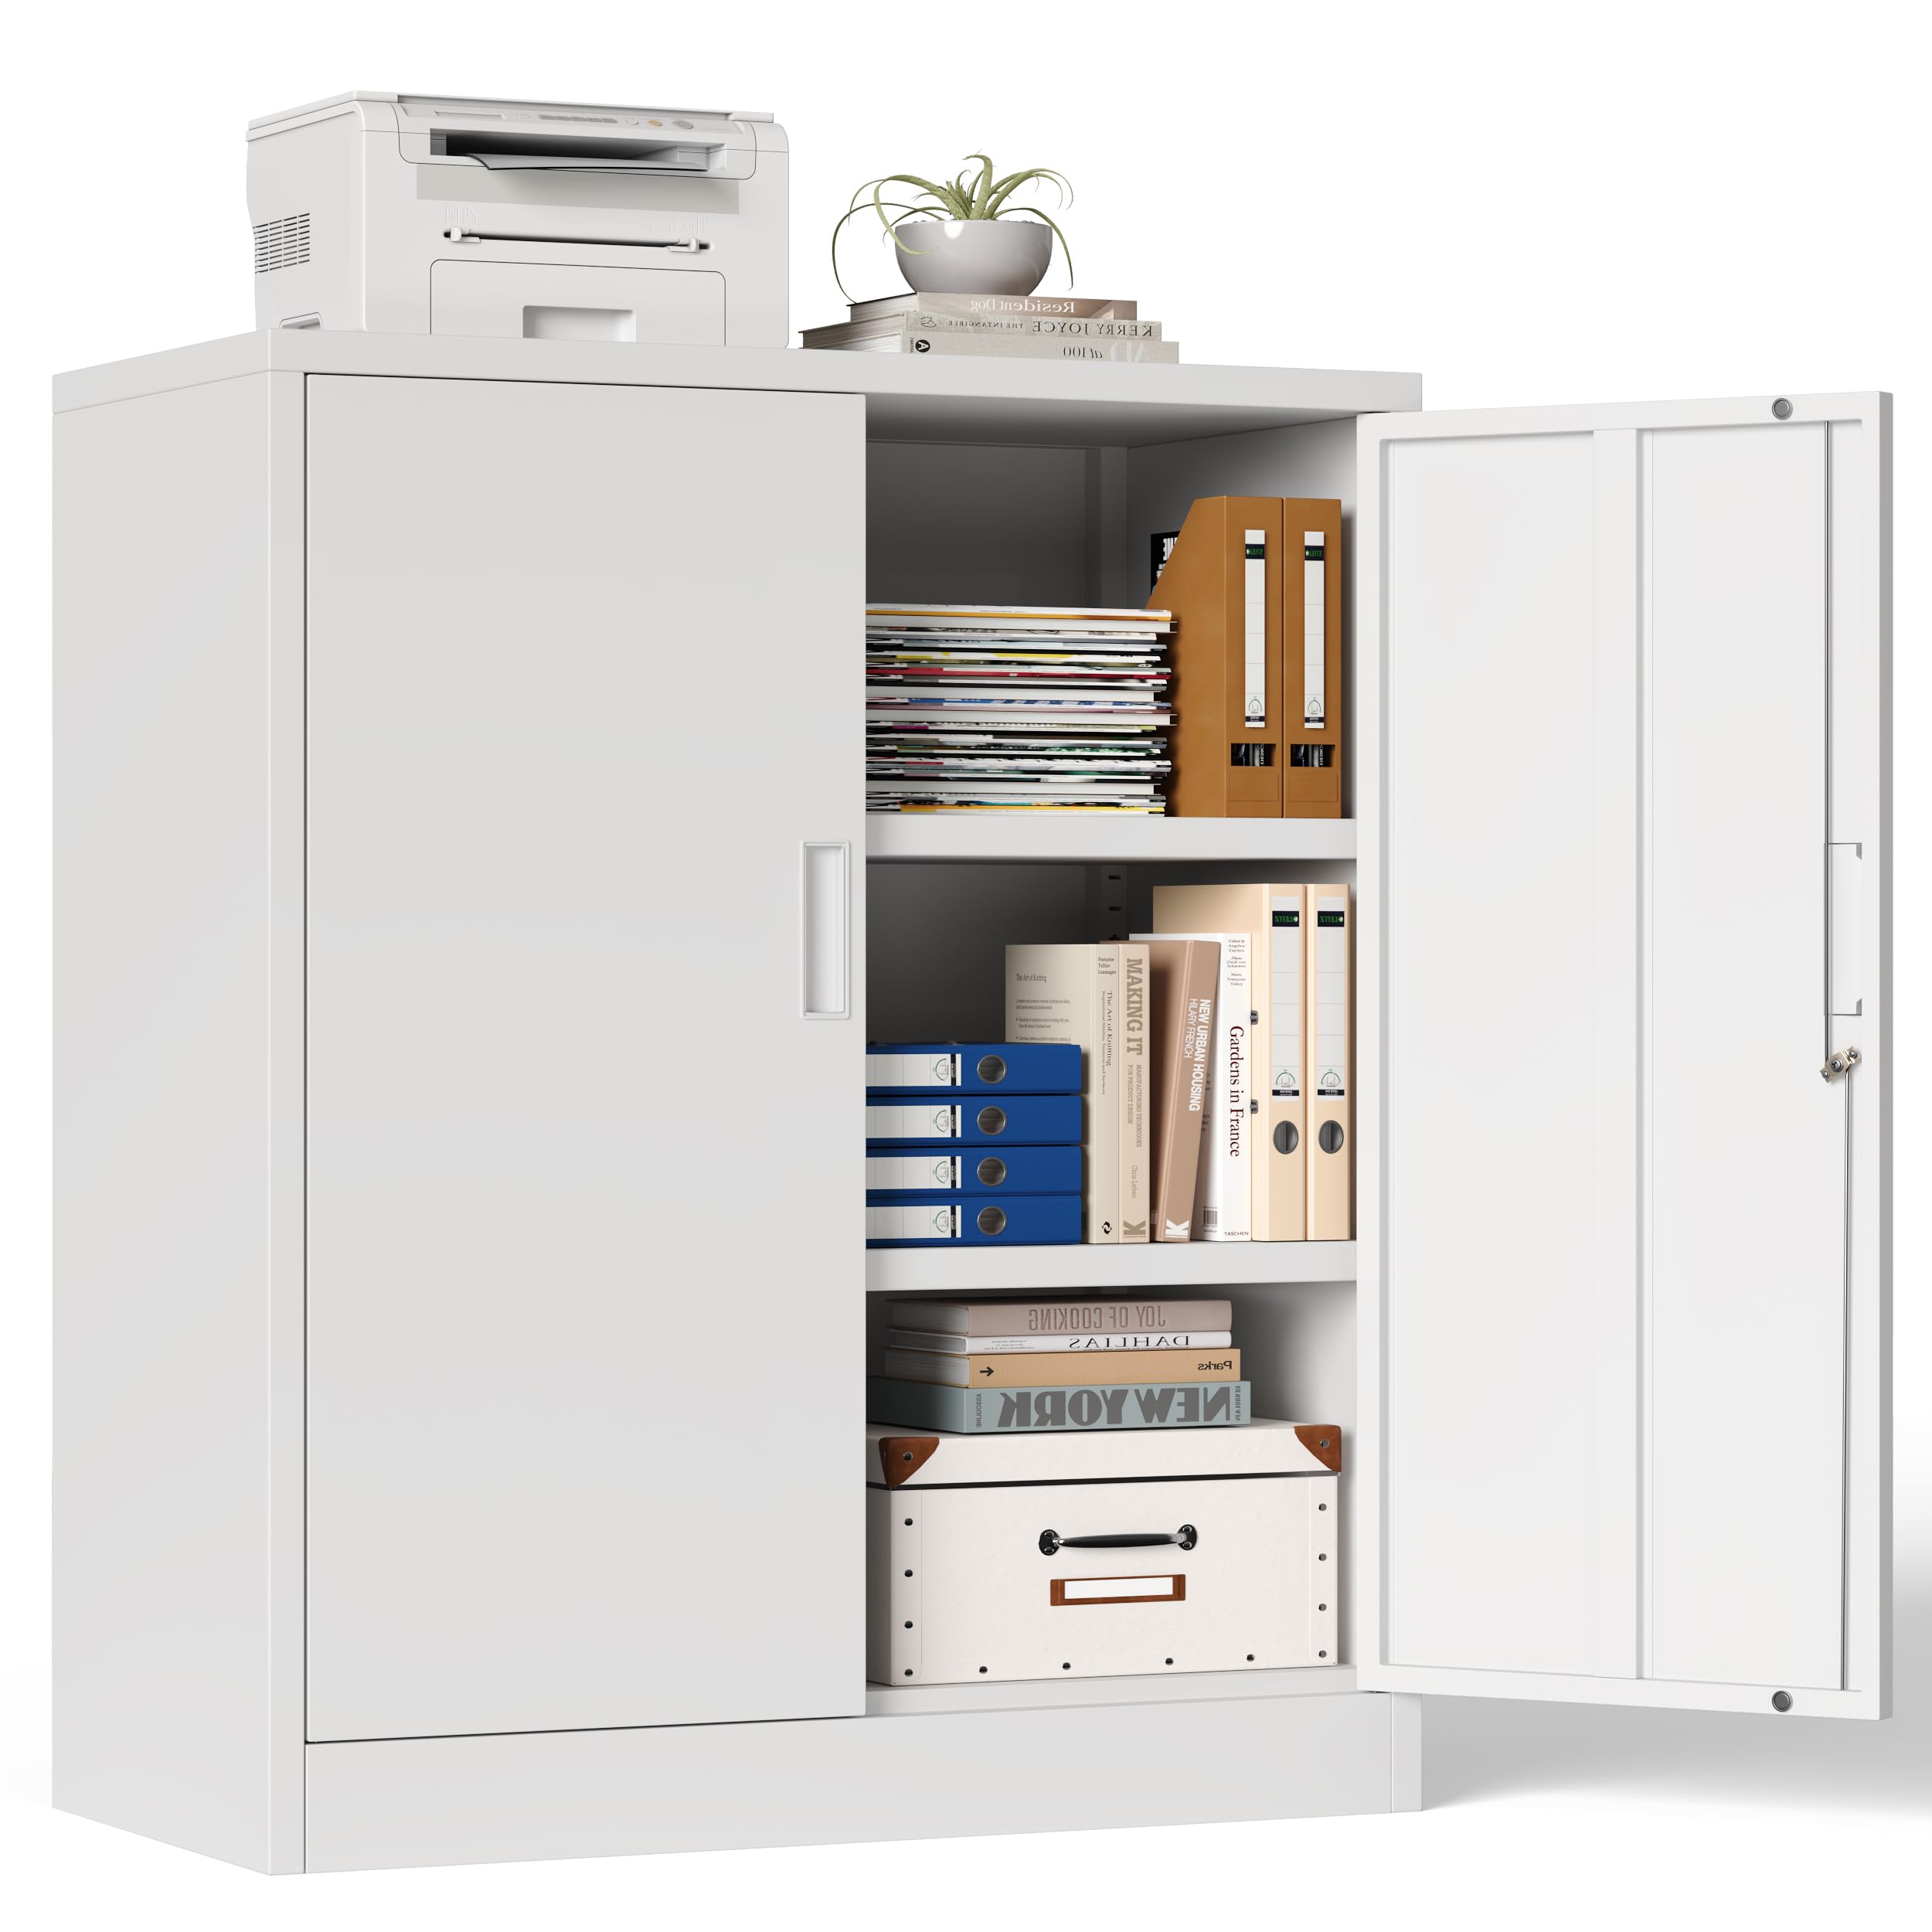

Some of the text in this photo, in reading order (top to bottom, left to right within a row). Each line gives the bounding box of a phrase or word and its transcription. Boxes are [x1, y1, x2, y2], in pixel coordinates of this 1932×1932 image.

[1107, 1023, 1113, 1032] of
[1126, 958, 1143, 1055] MAKING IT
[1184, 998, 1199, 1058] HILARY FRENCH
[1189, 998, 1211, 1111] NEW URBAN HOUSING
[1230, 1026, 1244, 1157] Gardens in France
